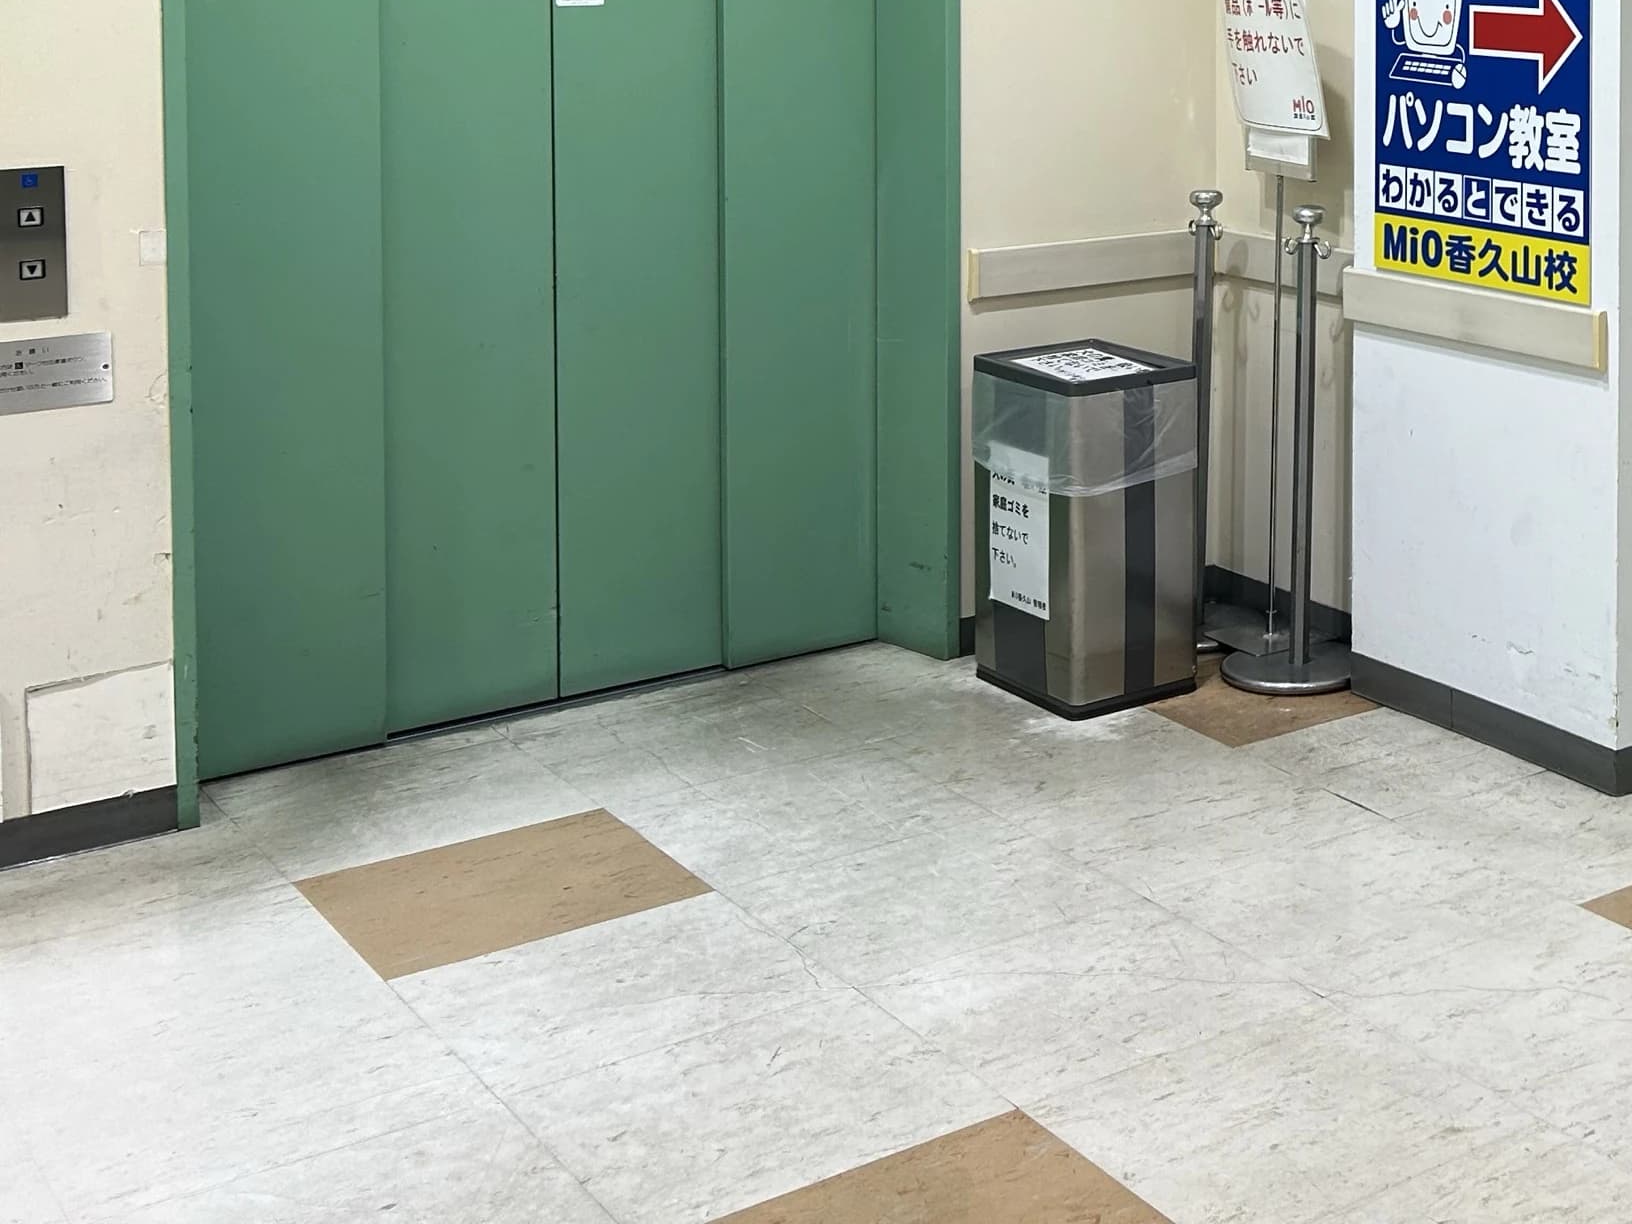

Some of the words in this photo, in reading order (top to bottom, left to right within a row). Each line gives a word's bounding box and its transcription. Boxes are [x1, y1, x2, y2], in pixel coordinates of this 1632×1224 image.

[1382, 90, 1582, 176] パソコン教室
[1380, 165, 1583, 236] わかるとできる
[1383, 222, 1578, 294] MiO香久山校
